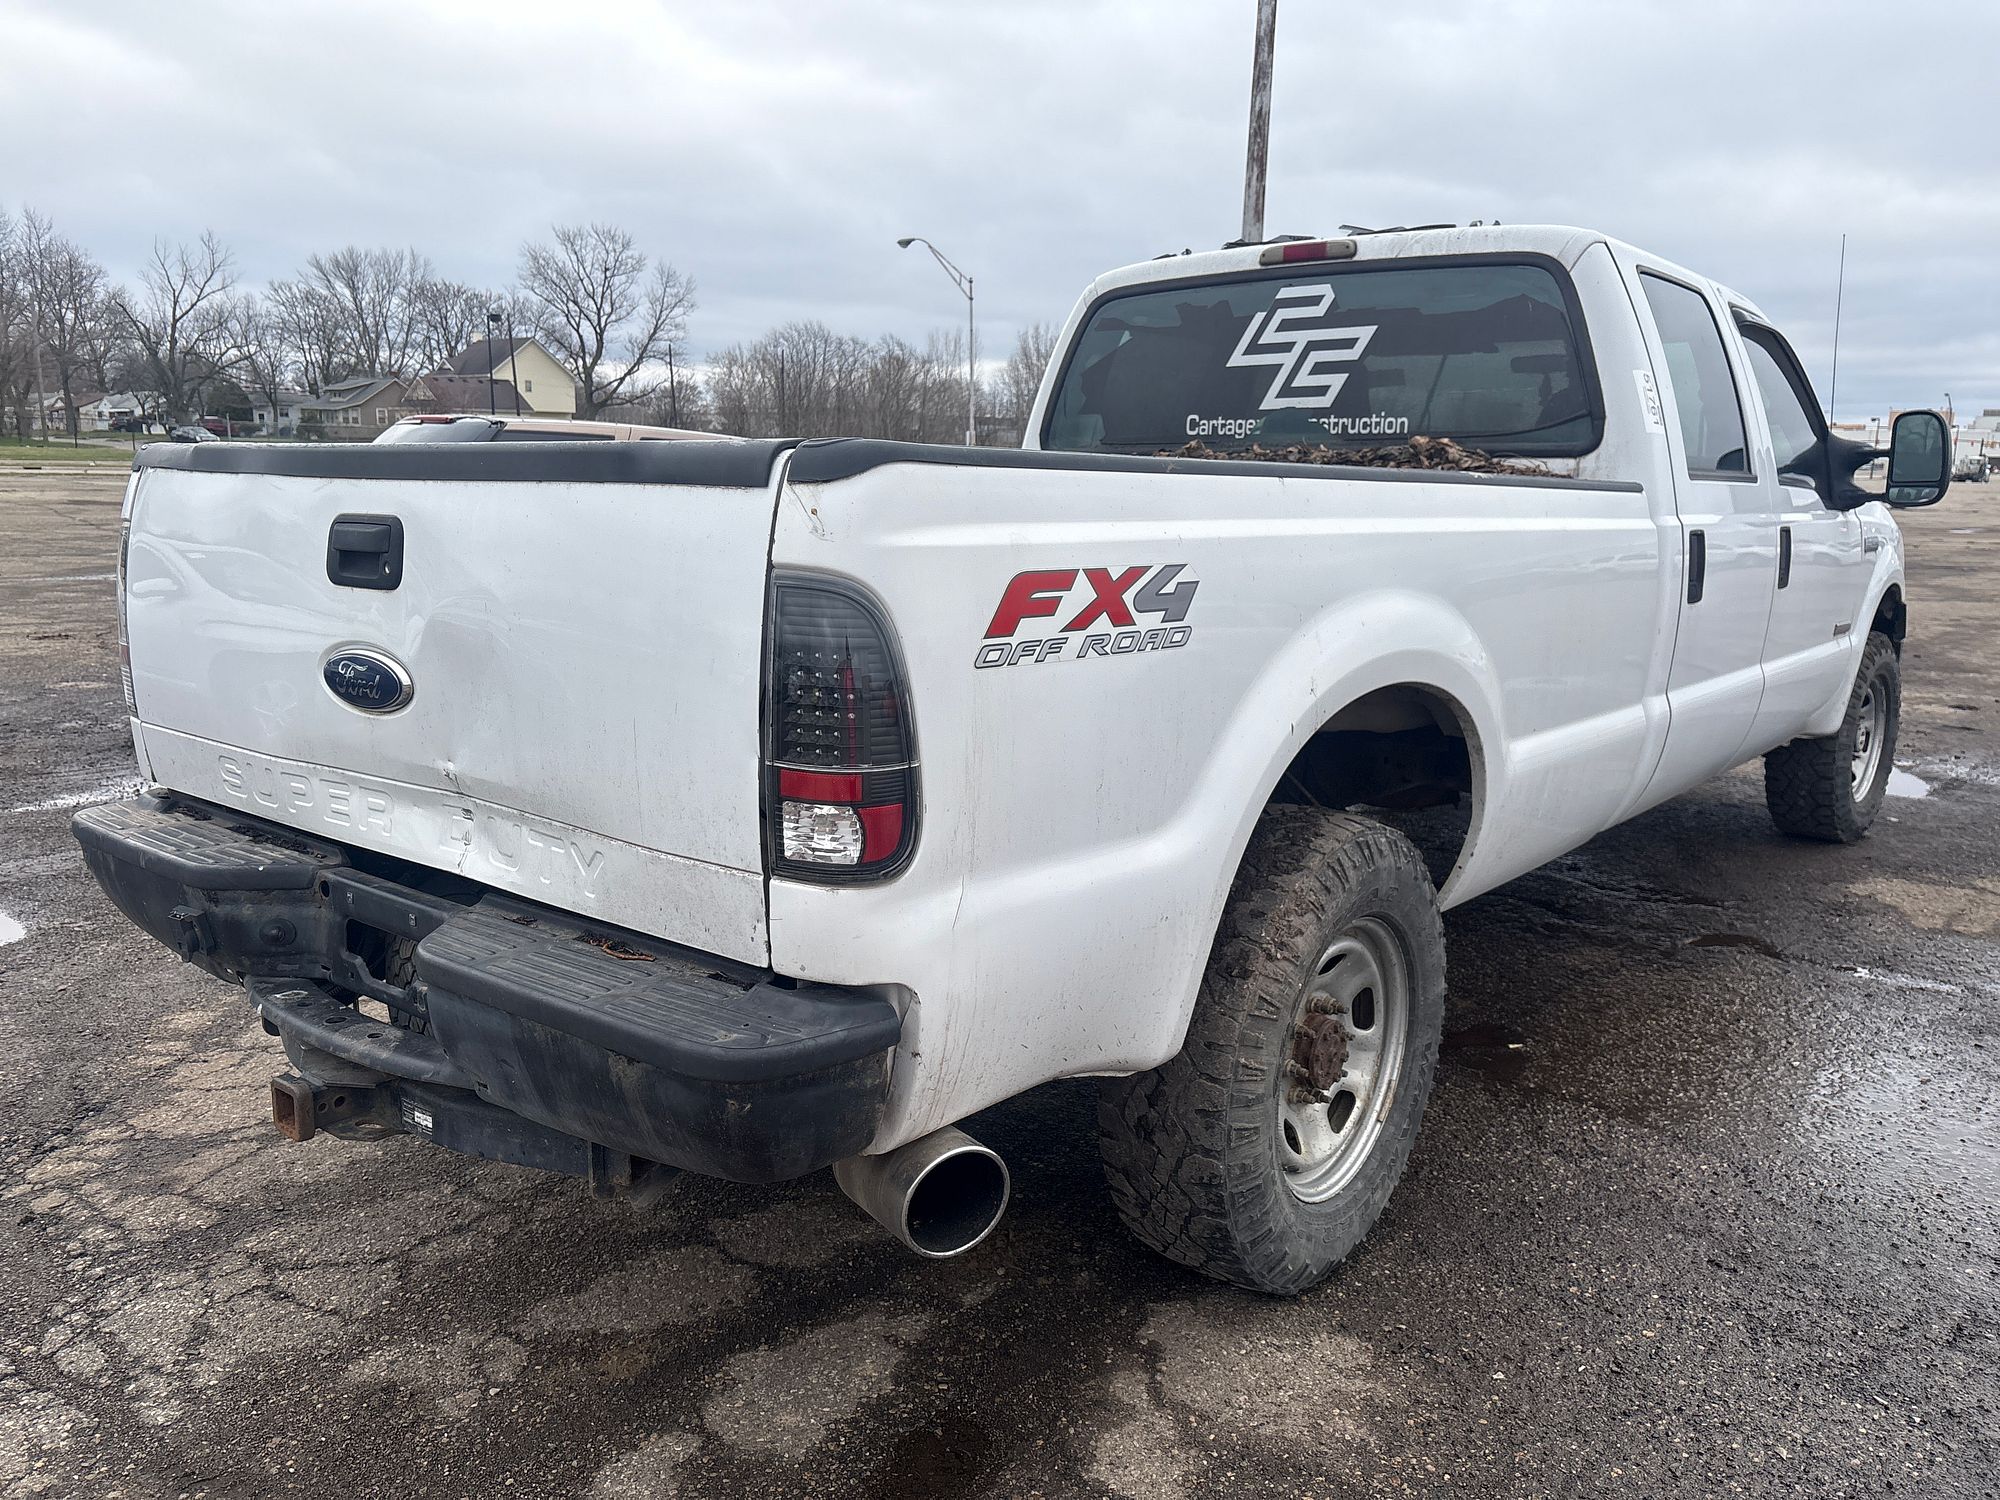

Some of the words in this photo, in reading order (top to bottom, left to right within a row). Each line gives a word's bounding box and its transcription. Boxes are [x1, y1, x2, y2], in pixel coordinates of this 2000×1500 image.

[1186, 414, 1257, 439] Cartage
[983, 564, 1200, 639] FX4
[974, 637, 1069, 669] OFF
[1076, 626, 1192, 659] ROAD
[336, 660, 382, 699] Ford
[217, 754, 393, 837] SUPER
[439, 802, 605, 899] DUTY
